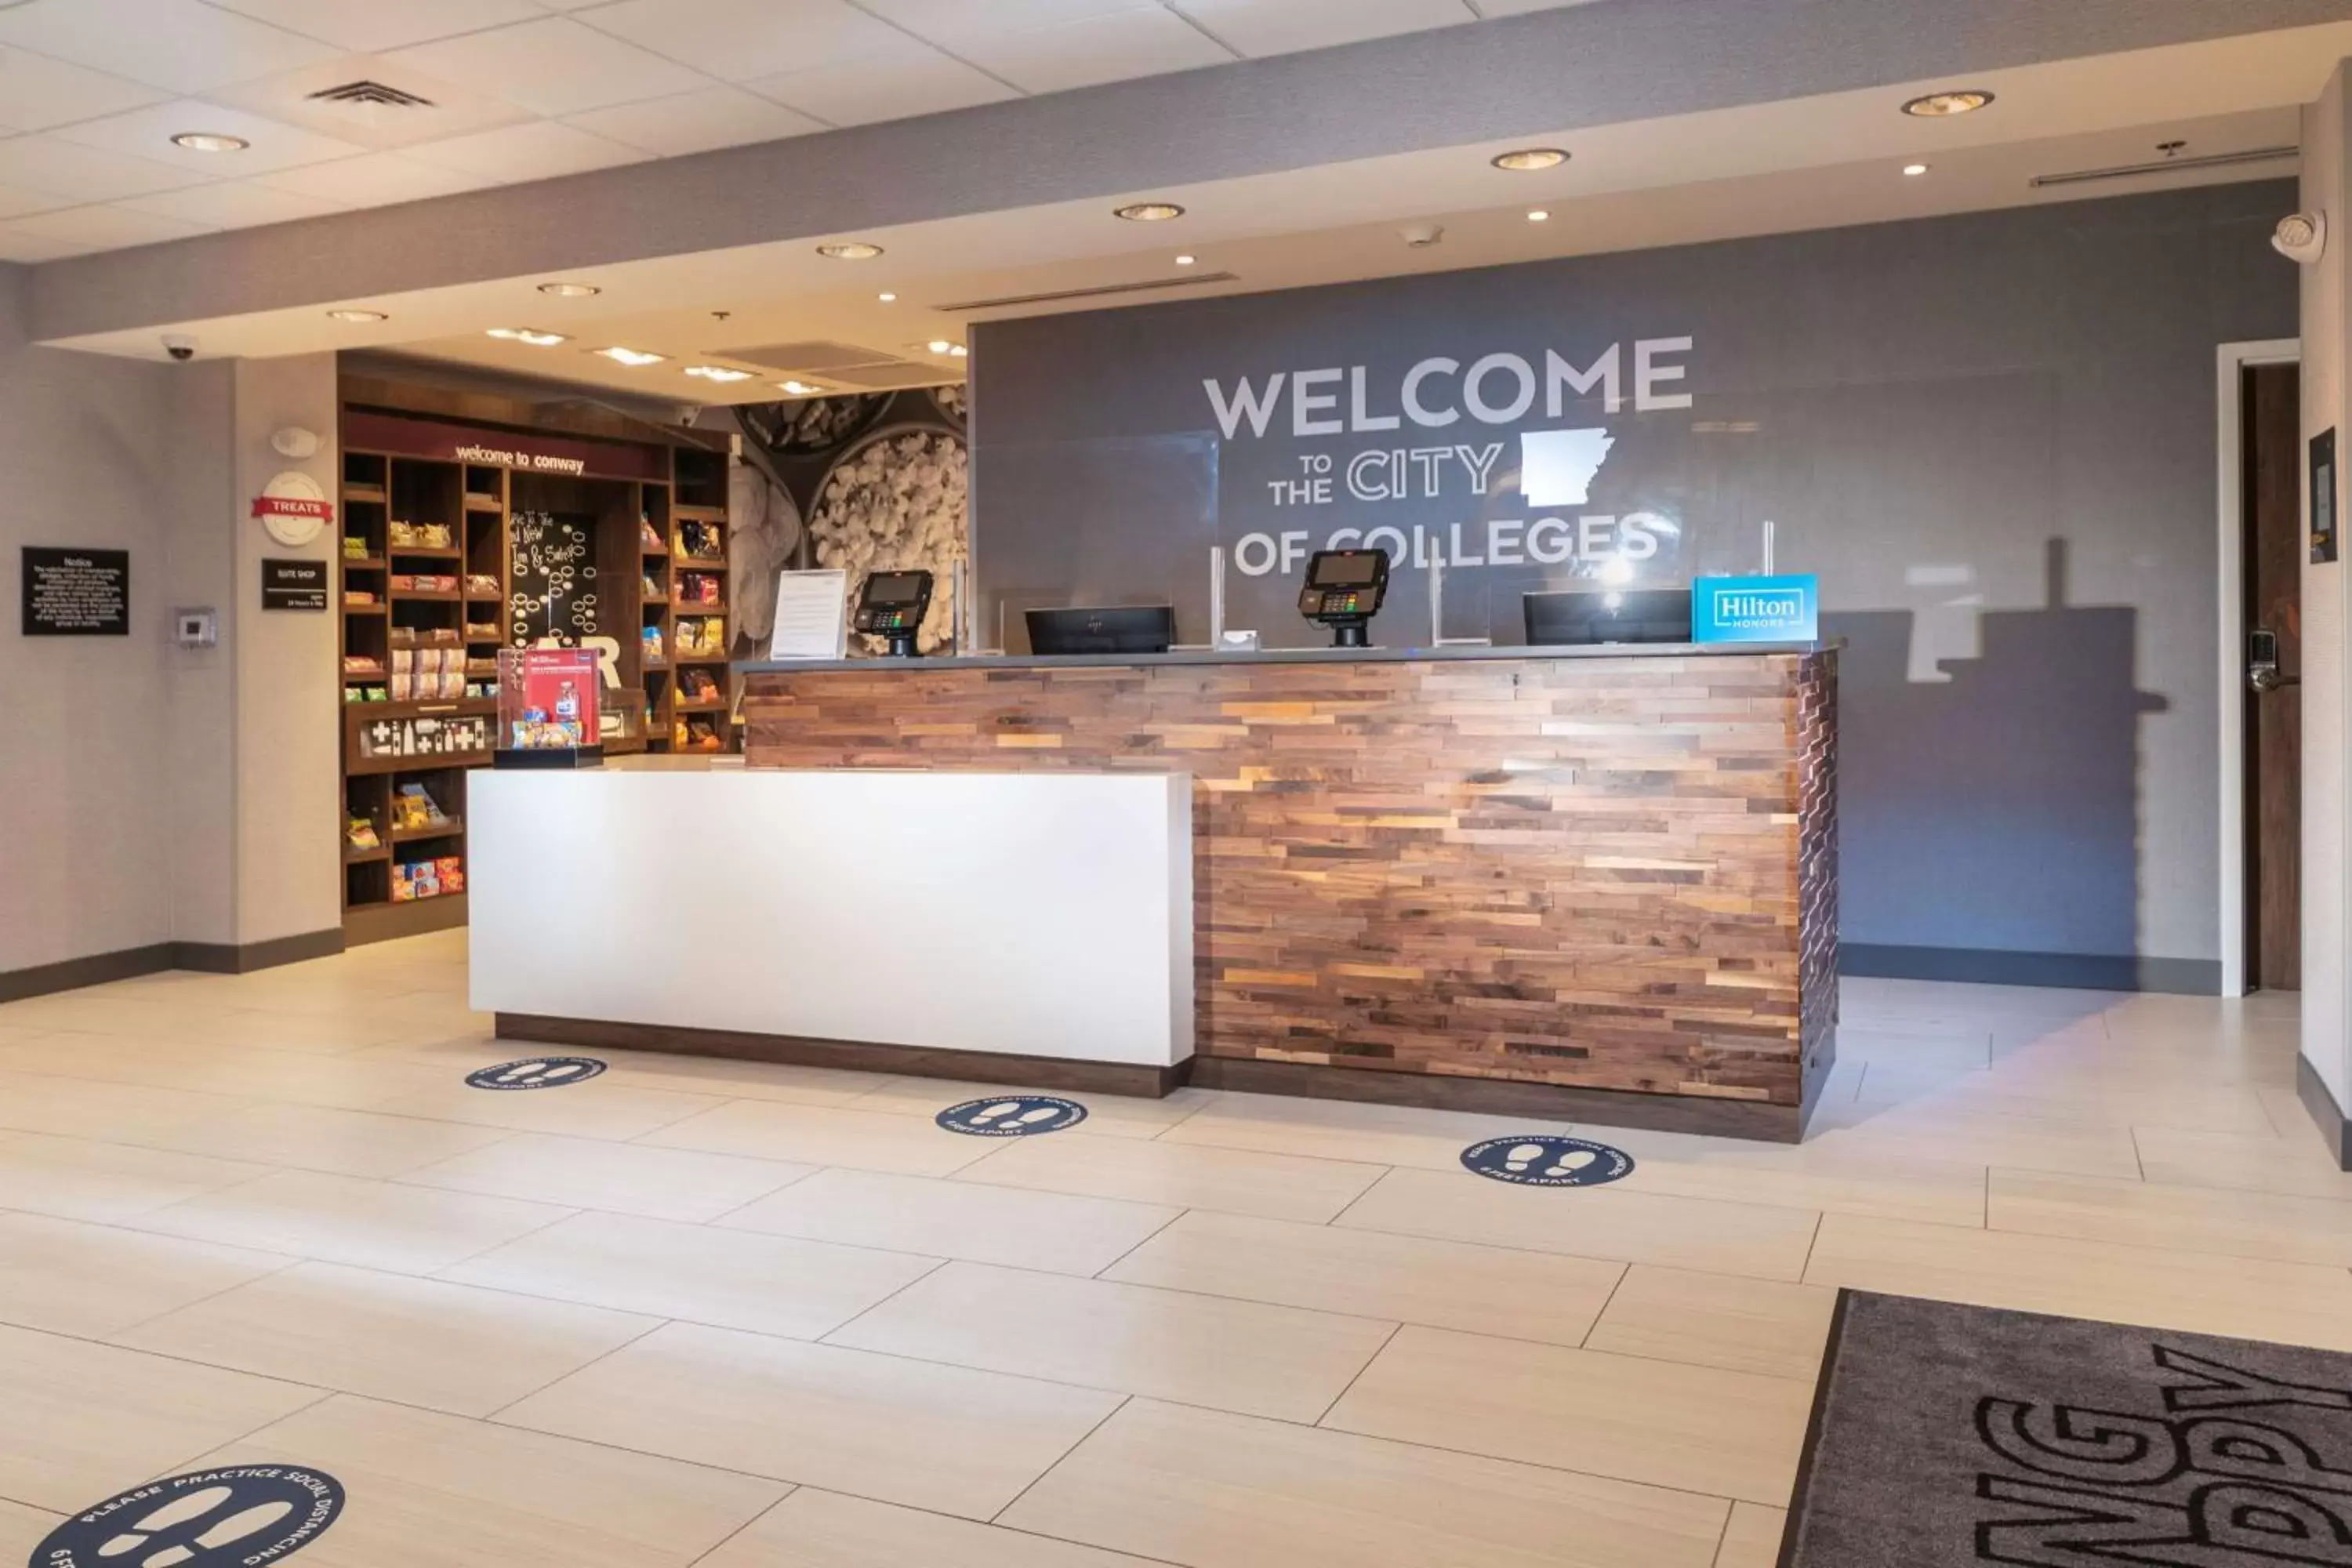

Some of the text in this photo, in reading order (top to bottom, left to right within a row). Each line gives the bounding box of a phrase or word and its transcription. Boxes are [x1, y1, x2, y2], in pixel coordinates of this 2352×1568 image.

[1203, 336, 1693, 440] WELCOME
[456, 444, 584, 476] welcome to conway
[1299, 455, 1331, 475] TO
[1269, 442, 1505, 506] THE CITY
[272, 500, 321, 514] TREATS
[64, 557, 93, 567] Notice
[1235, 530, 1308, 576] OF
[298, 570, 316, 579] SHOP
[1722, 597, 1795, 617] Hilton
[1733, 618, 1784, 628] HONORS
[80, 1468, 332, 1566] PLEASE PRACTICE SOCIAL DISTANCING
